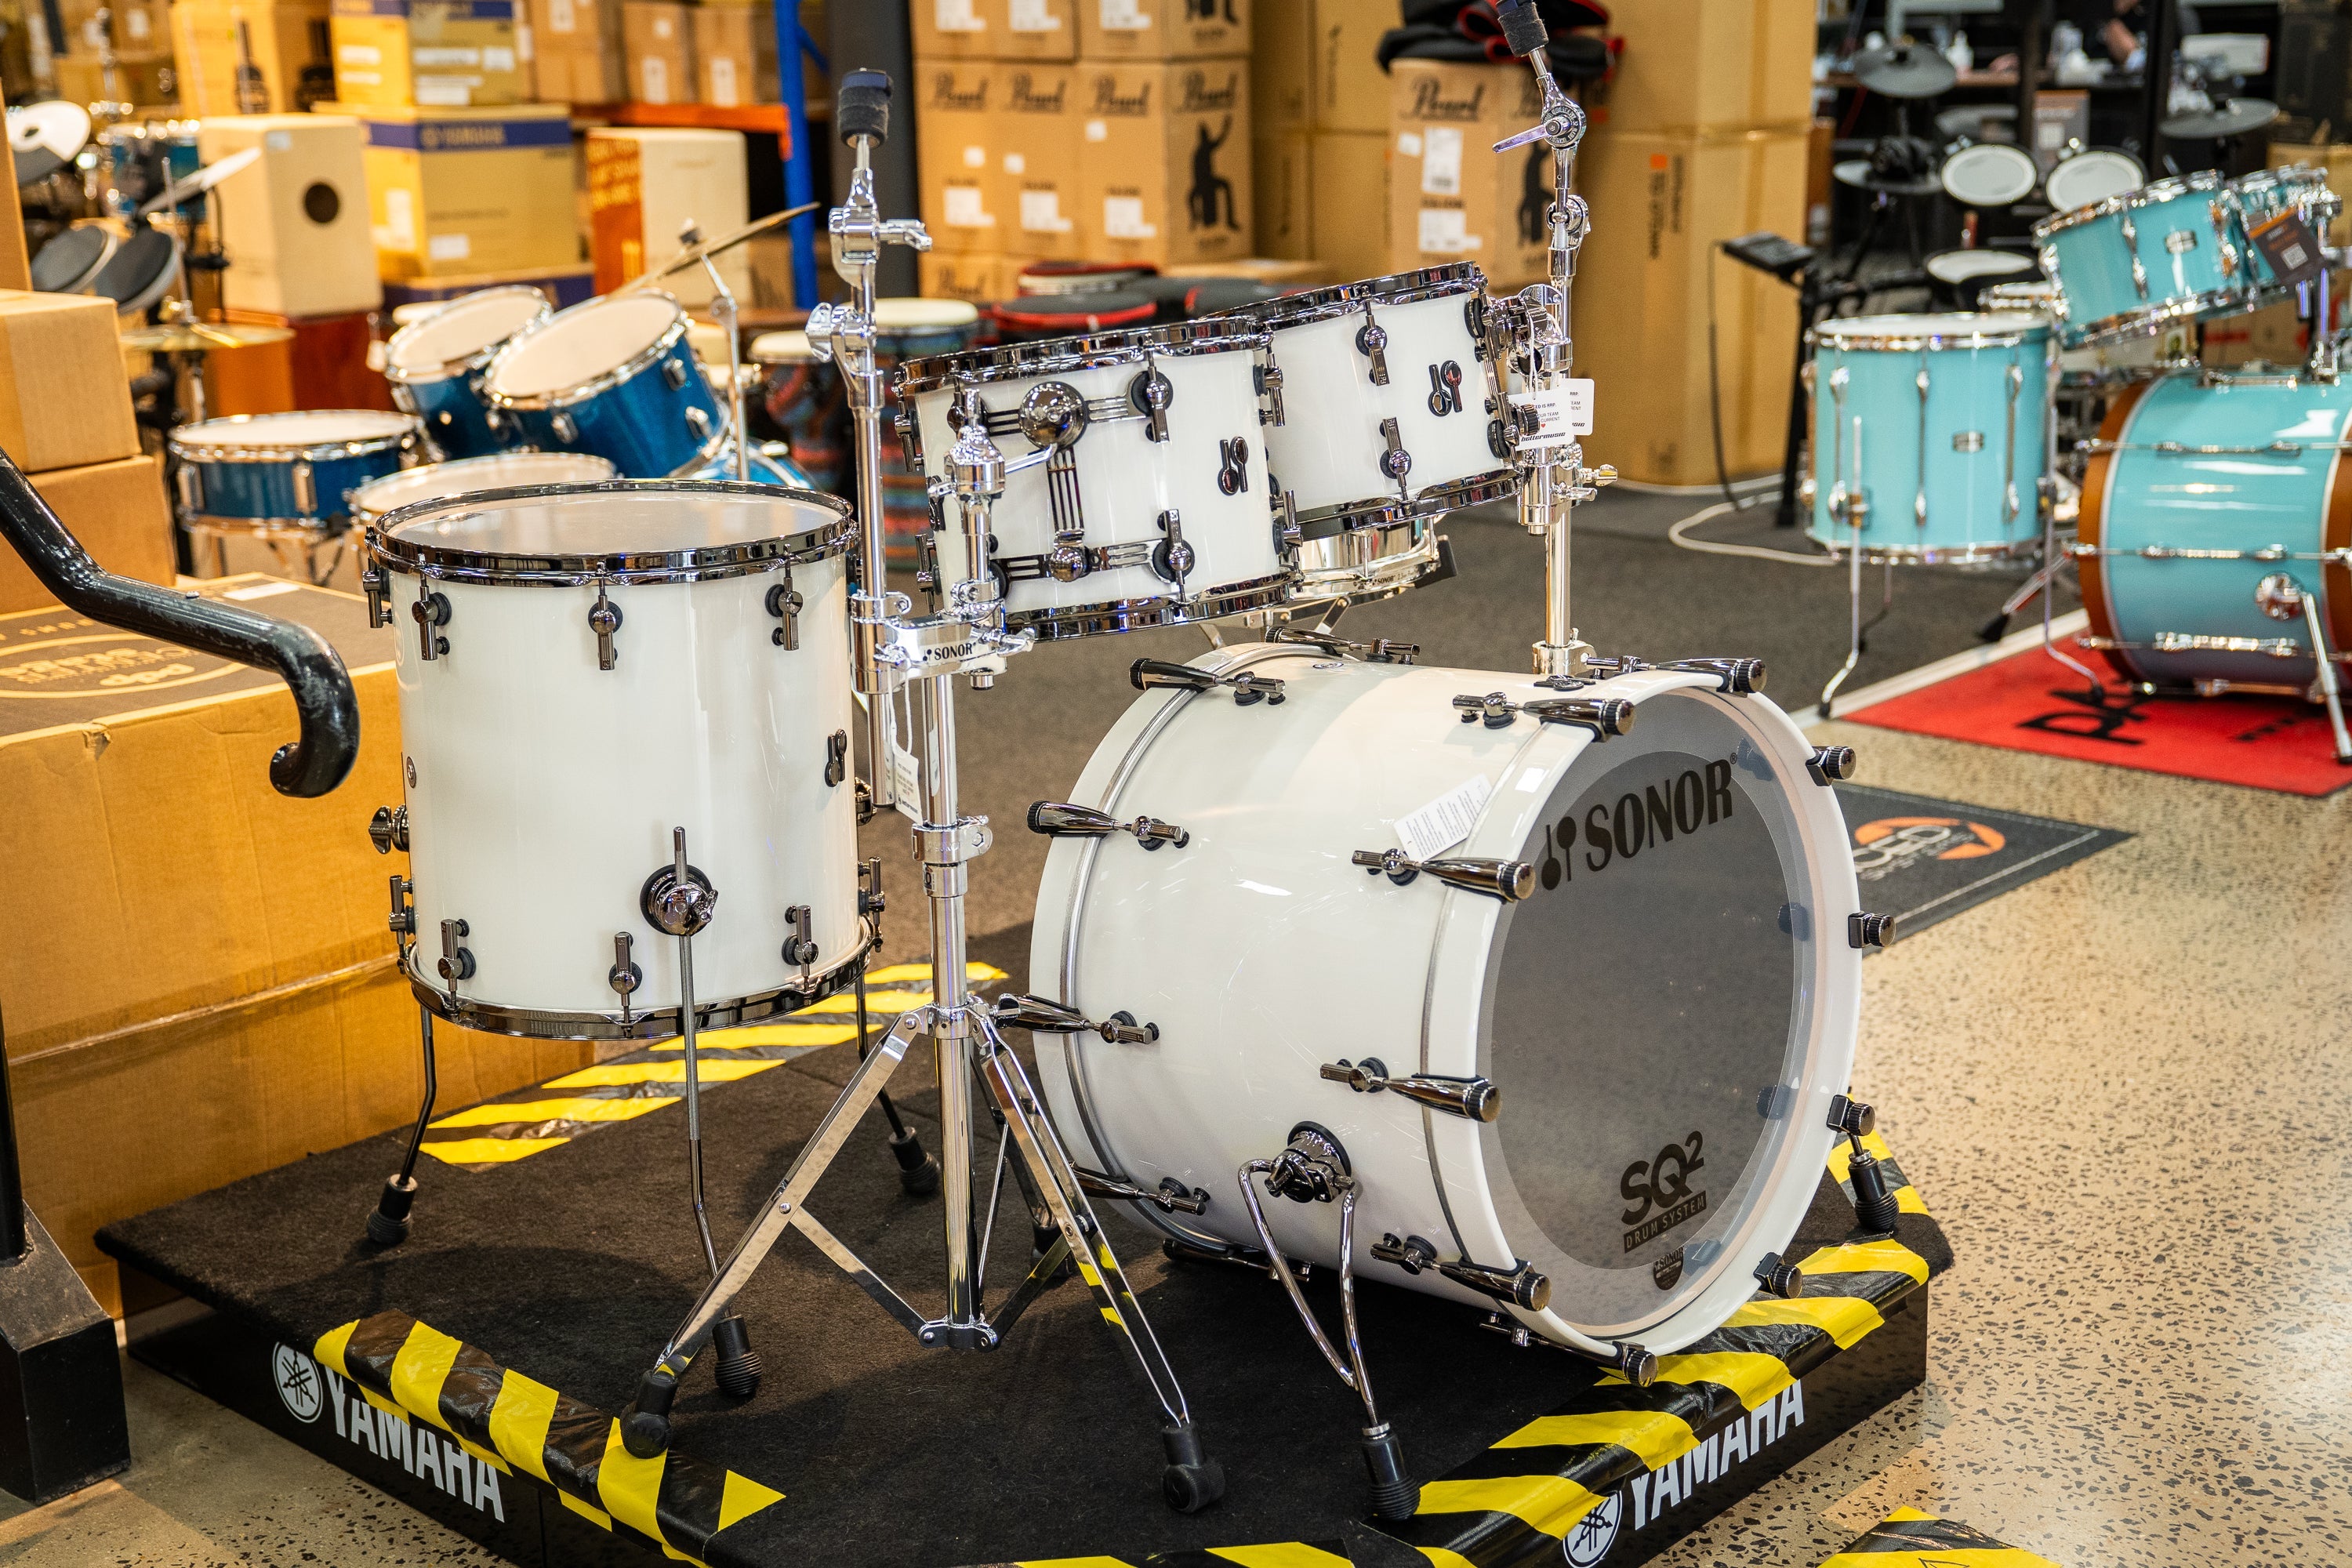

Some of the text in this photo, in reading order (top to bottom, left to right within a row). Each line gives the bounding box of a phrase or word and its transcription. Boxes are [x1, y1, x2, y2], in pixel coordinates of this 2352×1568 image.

[934, 643, 973, 660] SONOR
[1626, 1196, 1705, 1250] DRUM SYSTEM
[324, 1365, 505, 1523] YAMAHA
[1631, 1378, 1805, 1531] YAMAHA
